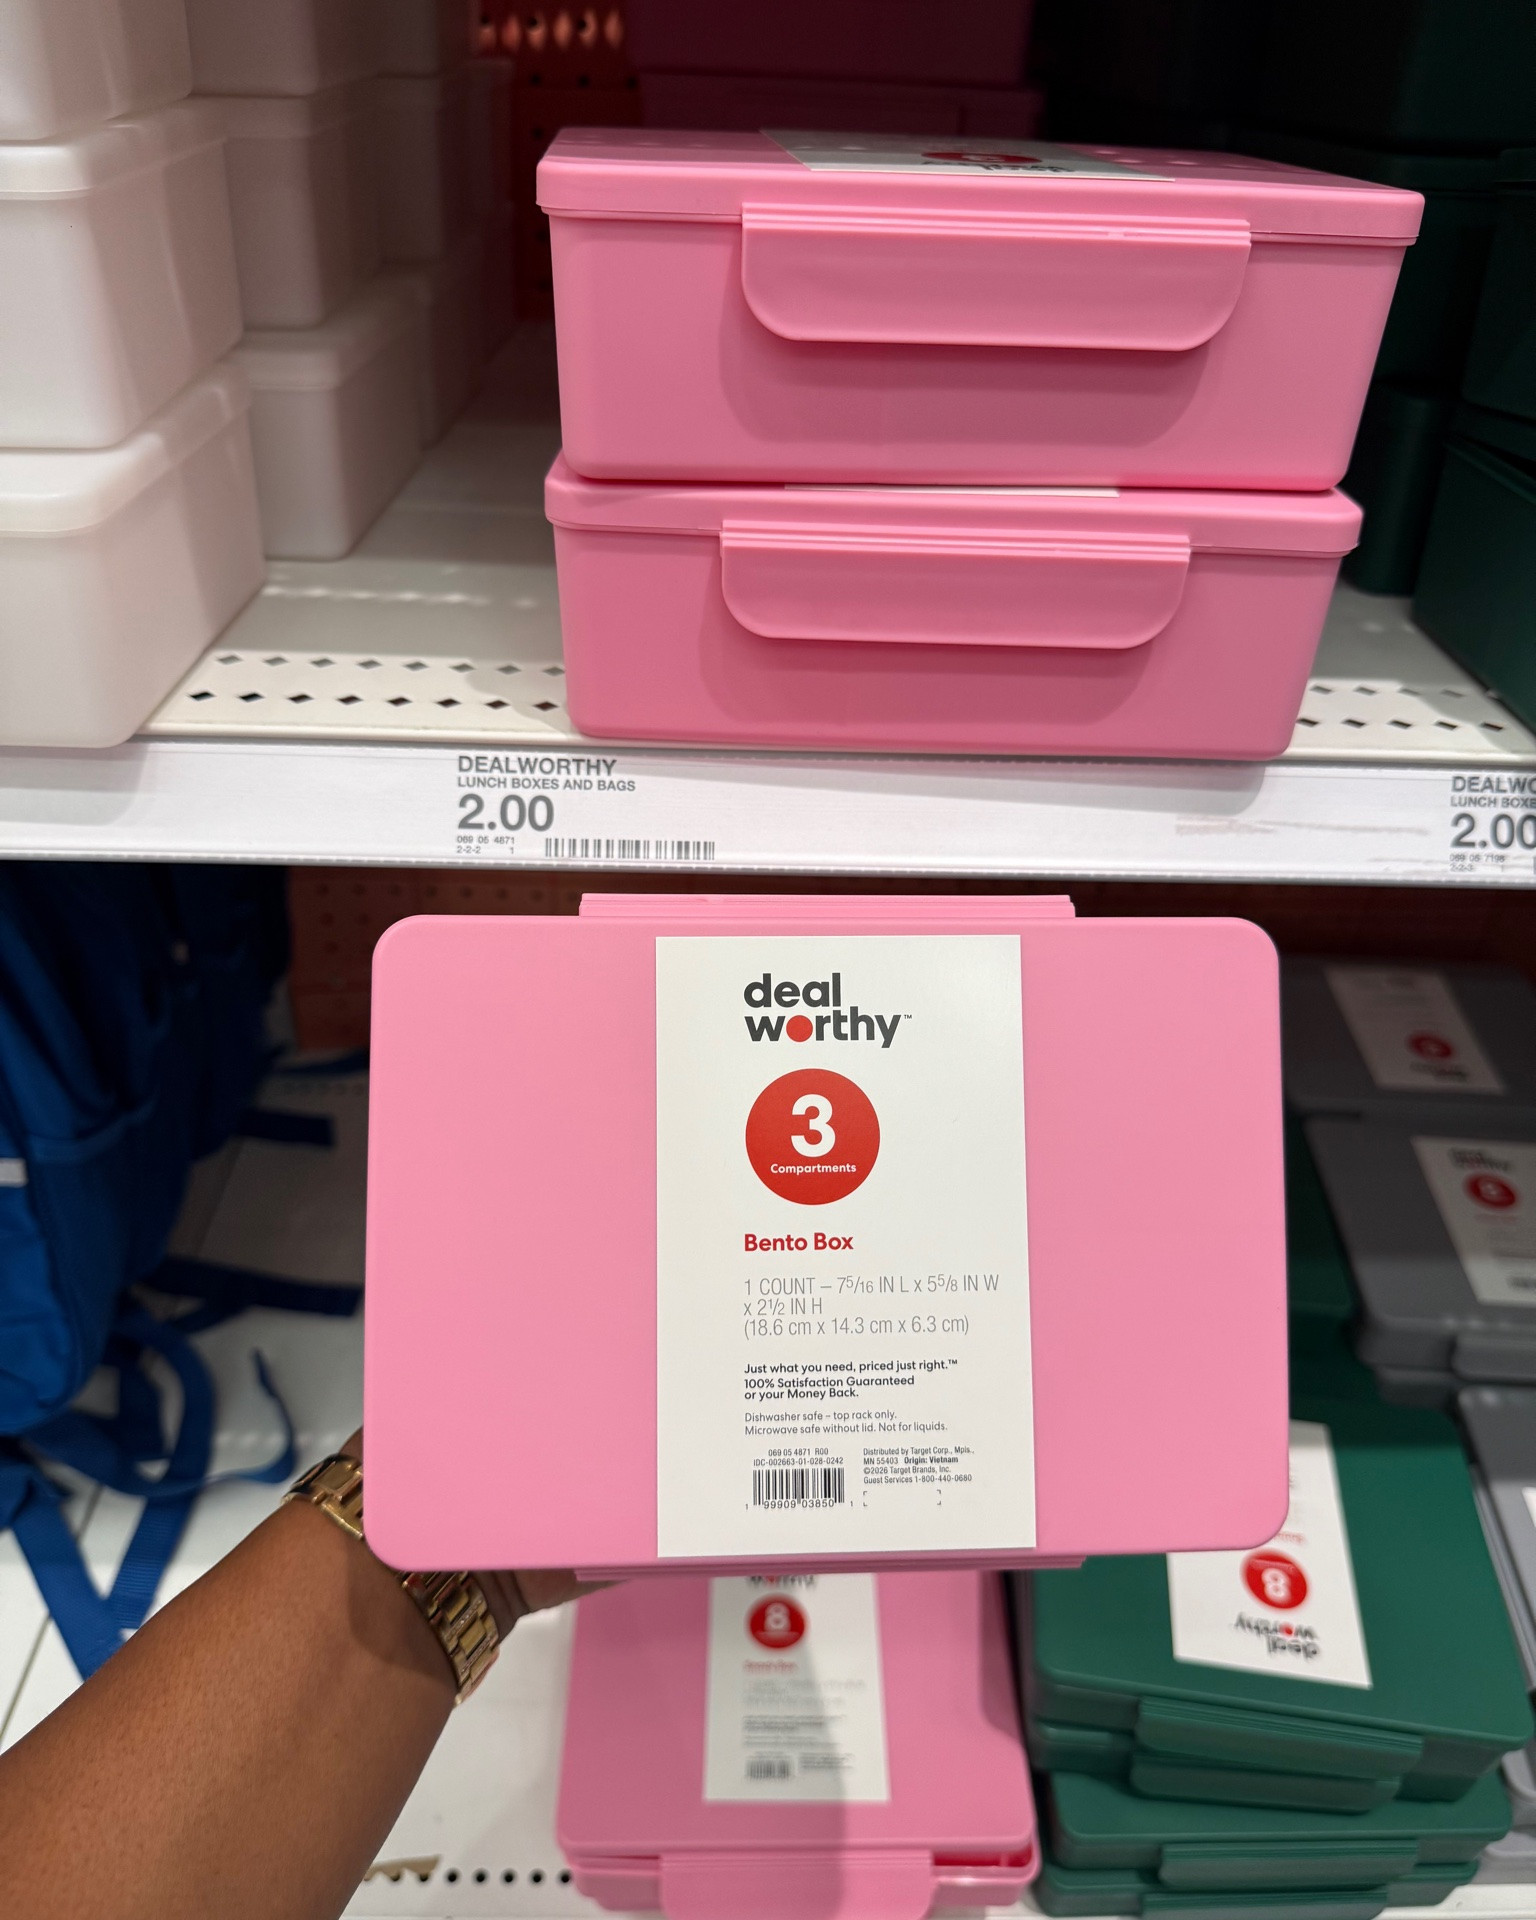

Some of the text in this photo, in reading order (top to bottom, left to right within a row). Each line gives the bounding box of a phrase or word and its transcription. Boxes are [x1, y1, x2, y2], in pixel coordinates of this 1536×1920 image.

[458, 755, 618, 776] DEALWORTHY
[457, 776, 636, 792] LUNCH BOXES AND BAGS
[1450, 796, 1497, 808] LUNCH
[457, 793, 555, 832] 2.00
[1450, 812, 1536, 850] 2.00
[456, 835, 474, 845] 069
[493, 836, 516, 846] 4871
[456, 845, 482, 854] 2-2-2
[743, 972, 842, 1009] deal
[790, 1093, 836, 1158] 3
[770, 1163, 857, 1176] Compartments
[744, 1232, 854, 1252] Bento Box
[744, 1280, 752, 1296] 1
[759, 1277, 816, 1296] COUNT
[878, 1275, 895, 1293] IN
[899, 1275, 910, 1293] L
[913, 1279, 922, 1293] x
[962, 1274, 979, 1292] IN
[983, 1273, 1000, 1292] W
[743, 1301, 752, 1316] x
[790, 1298, 806, 1315] IN
[811, 1297, 823, 1315] H
[744, 1314, 969, 1340] (18.6 cm x 14.3 cm x 6.3 cm)
[744, 1363, 767, 1374] Just
[770, 1363, 799, 1373] what
[801, 1364, 822, 1375] you
[825, 1361, 856, 1373] need,
[859, 1360, 894, 1374] priced
[896, 1360, 916, 1373] just
[744, 1375, 915, 1389] 100% Satisfaction Guaranteed
[744, 1387, 860, 1402] or your Money Back.
[744, 1412, 801, 1422] Dishwasher
[802, 1411, 823, 1421] safe
[833, 1411, 850, 1422] top
[851, 1410, 873, 1420] rack
[874, 1409, 897, 1421] only.
[744, 1421, 948, 1436] Microwave safe without lid. Not for liquids.
[768, 1449, 782, 1457] 069
[794, 1448, 811, 1456] 4871
[863, 1447, 900, 1456] Distributed
[901, 1447, 909, 1456] by
[911, 1446, 932, 1456] Target
[932, 1446, 953, 1455] Corp.,
[863, 1455, 959, 1465] MN 55403 Origin: Vietnam
[863, 1464, 951, 1475] ©2026 Target Brands, Inc.
[863, 1474, 973, 1484] Guest Services 1-800-440-0680
[763, 1500, 797, 1510] 99909
[801, 1499, 835, 1508] 03850
